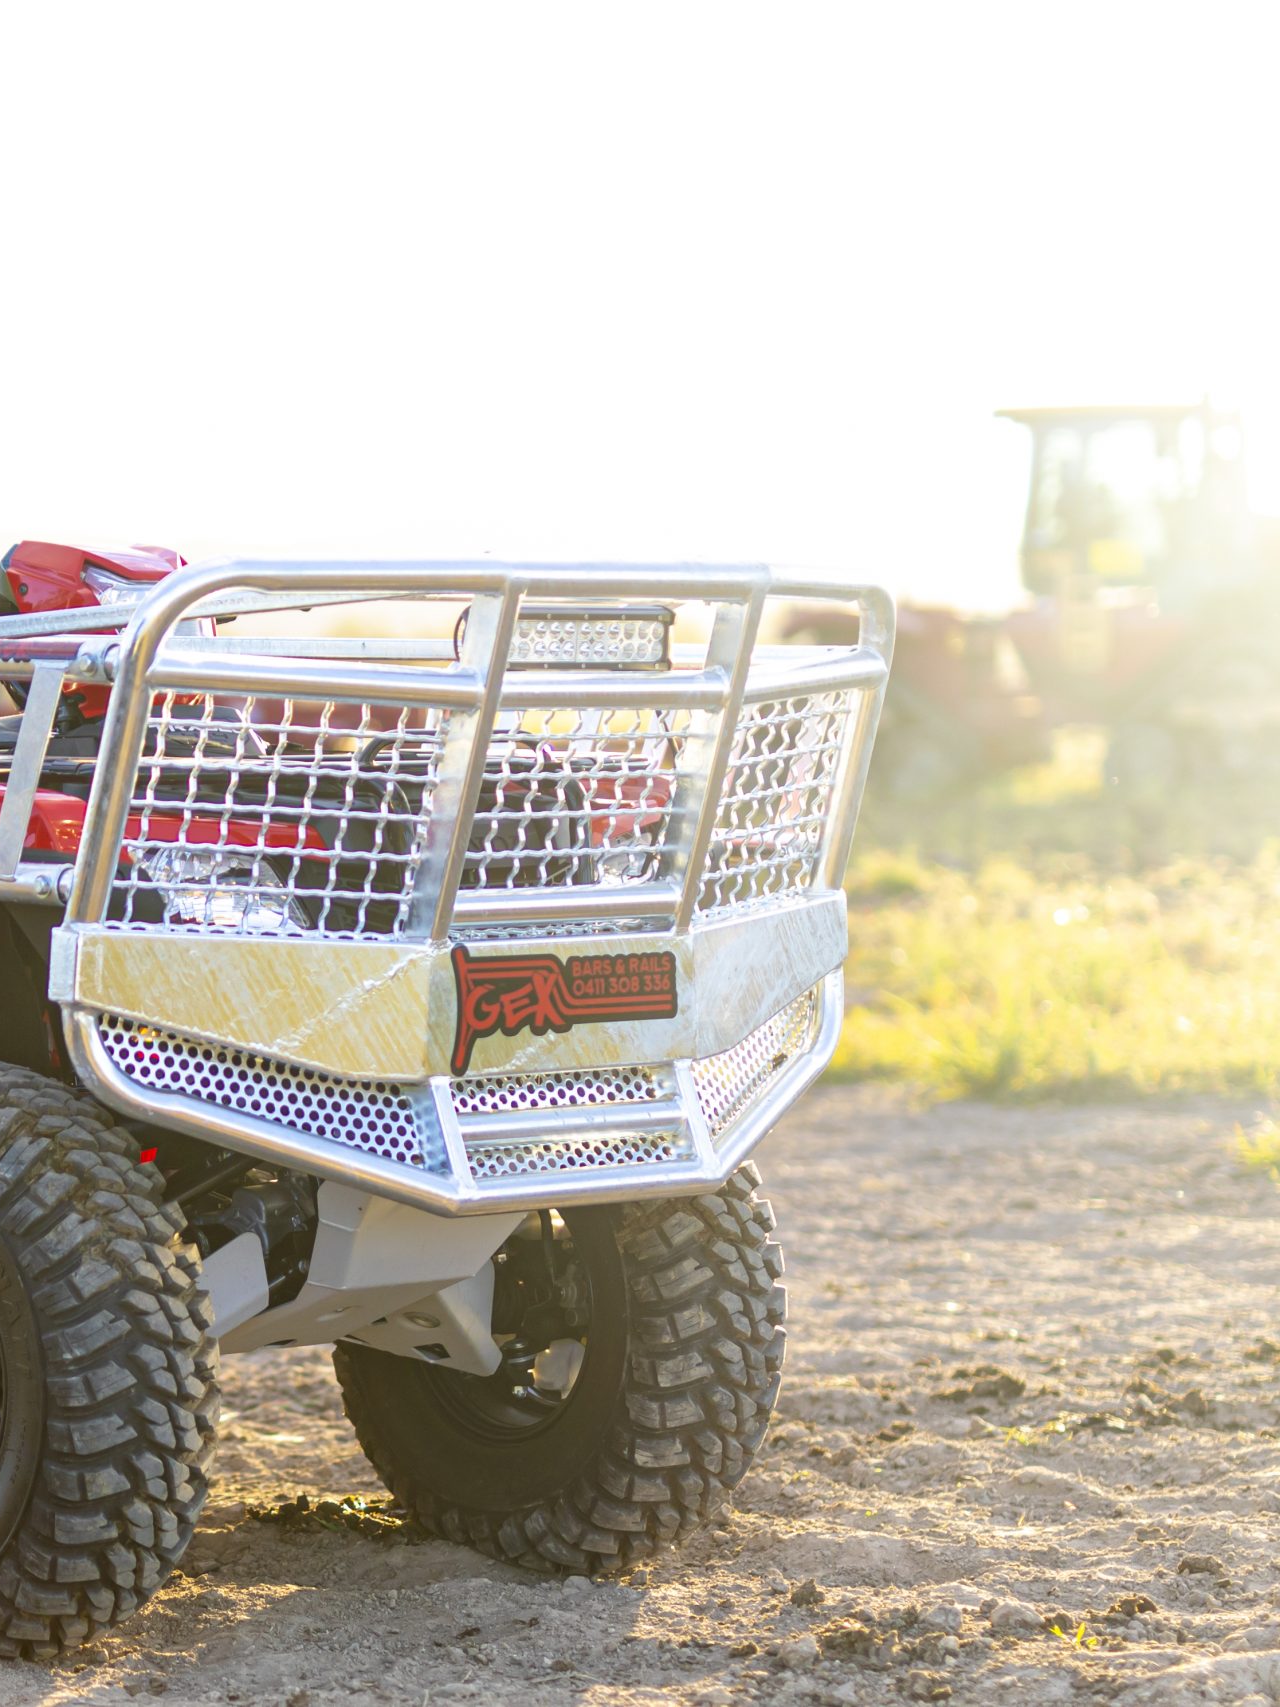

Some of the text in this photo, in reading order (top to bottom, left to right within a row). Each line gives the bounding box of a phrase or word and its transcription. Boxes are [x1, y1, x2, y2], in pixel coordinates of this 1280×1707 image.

[572, 953, 672, 977] BARS & RAILS
[572, 973, 671, 996] 0411 308 336
